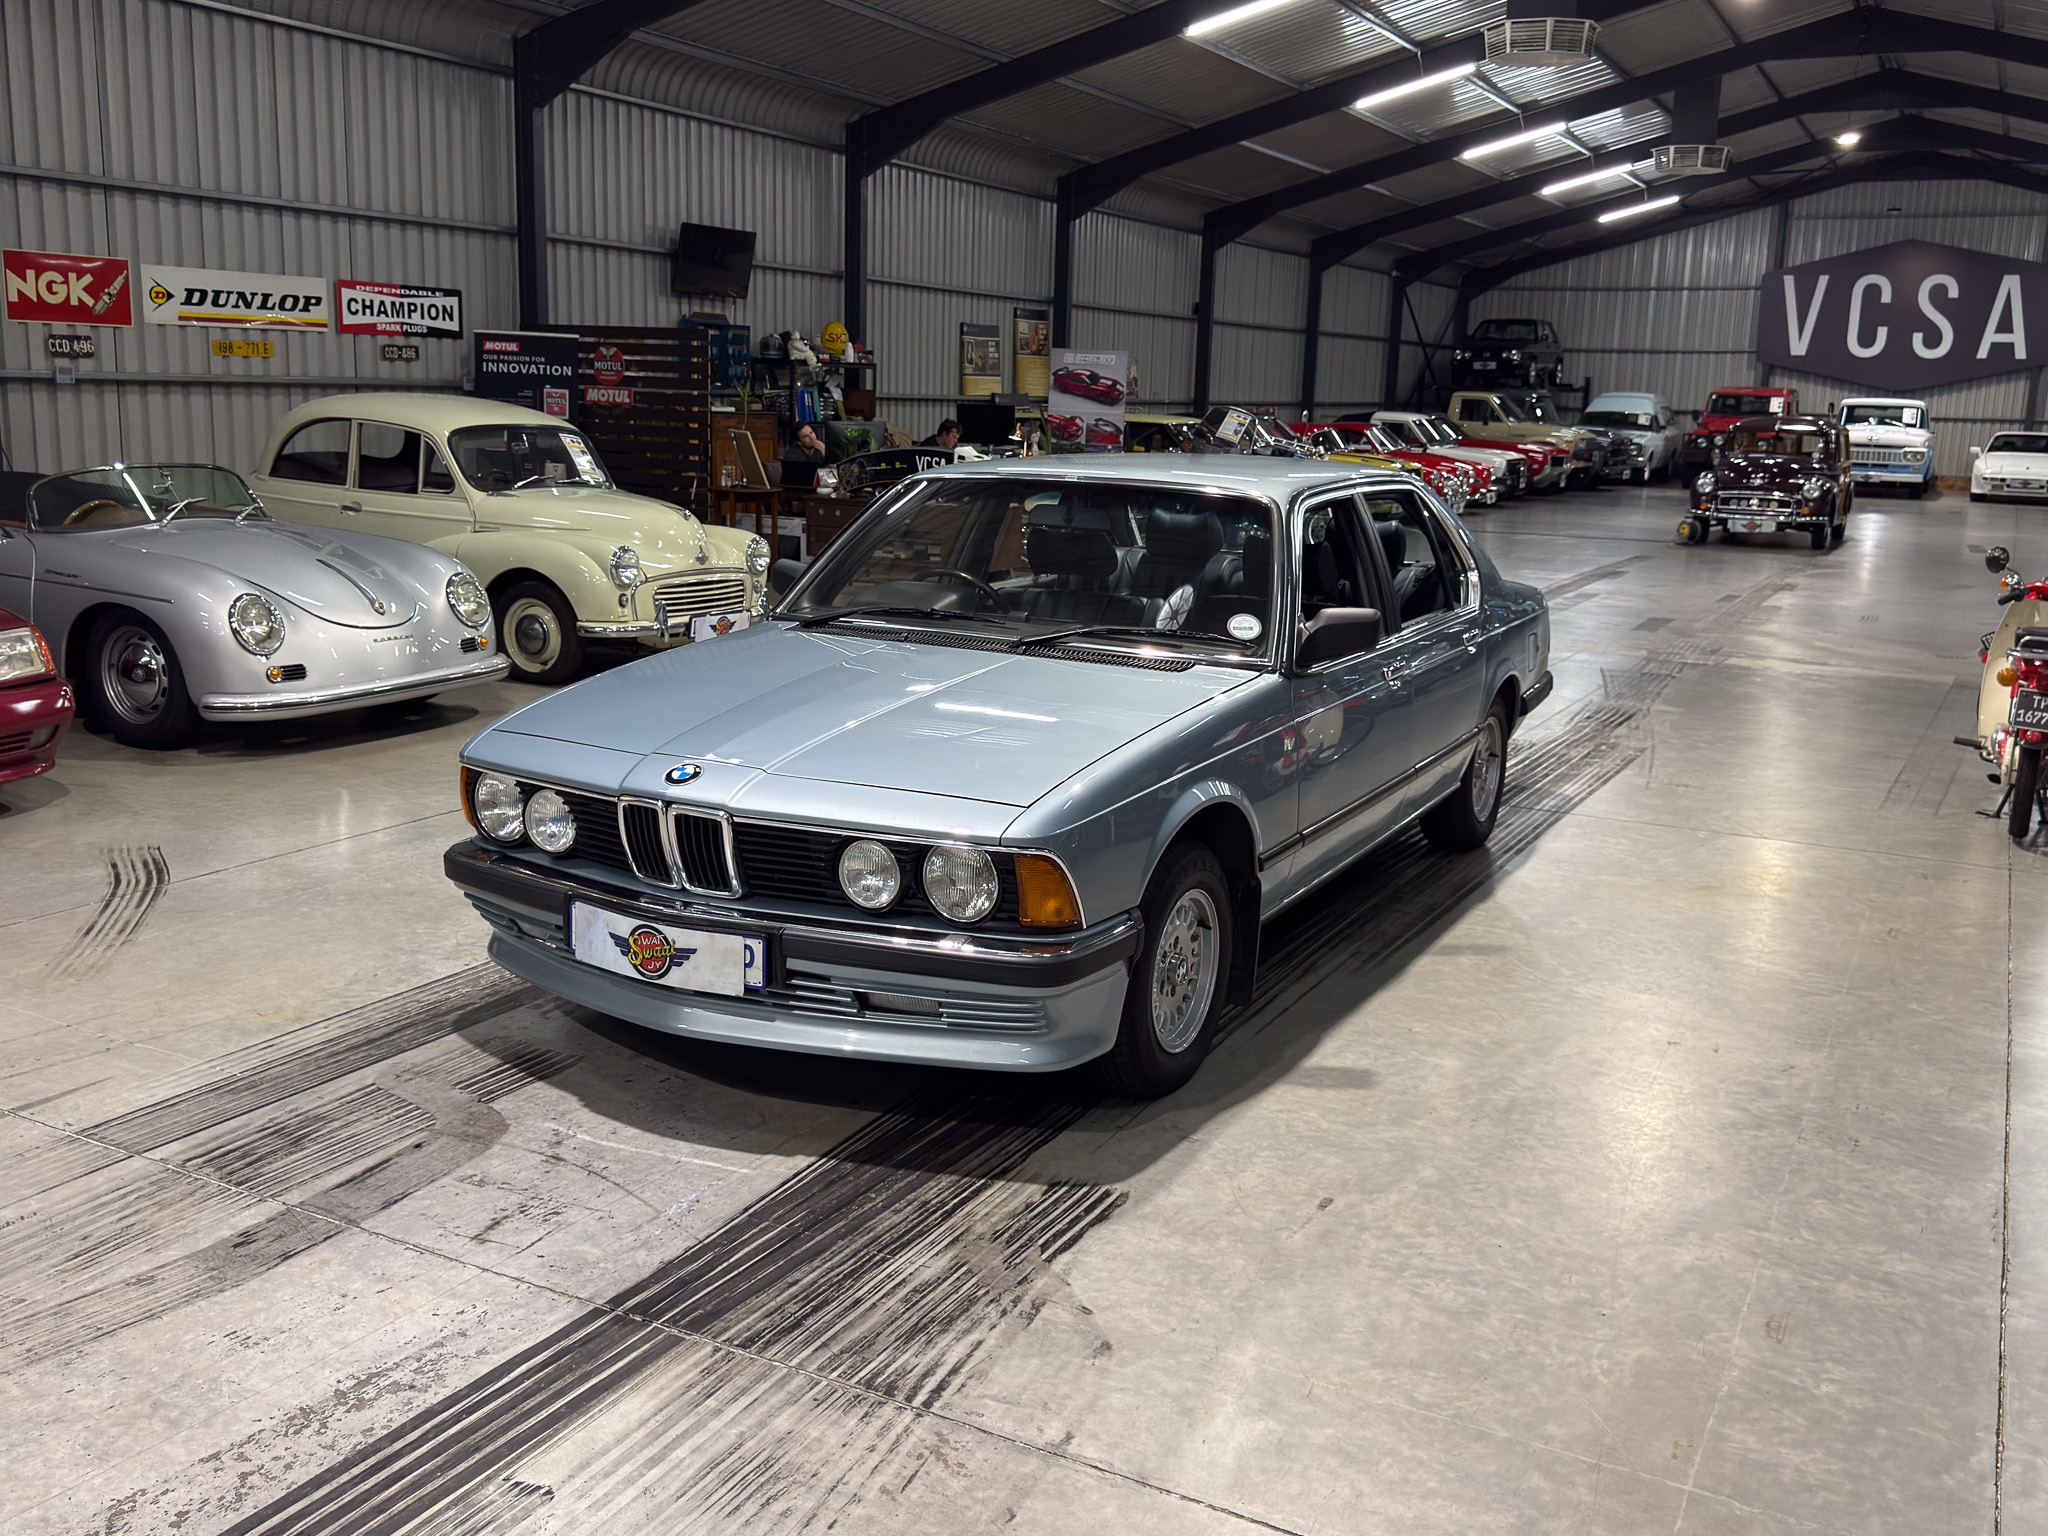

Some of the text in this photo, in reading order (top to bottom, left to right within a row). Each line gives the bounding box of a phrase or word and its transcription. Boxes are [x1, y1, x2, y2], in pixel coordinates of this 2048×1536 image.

[5, 268, 96, 308] NGK
[356, 285, 444, 297] DEPENDABLE
[153, 288, 323, 313] D DUNLOP
[346, 297, 454, 322] CHAMPION
[1783, 274, 2027, 360] VCSA
[376, 323, 428, 334] SPARK PLUGS
[48, 339, 70, 353] CCD
[484, 342, 519, 352] MOTUL
[483, 361, 573, 376] INNOVATION
[594, 361, 623, 371] MOTUL
[587, 388, 631, 404] MOTUL
[641, 935, 665, 946] WAT
[647, 961, 662, 969] JY
